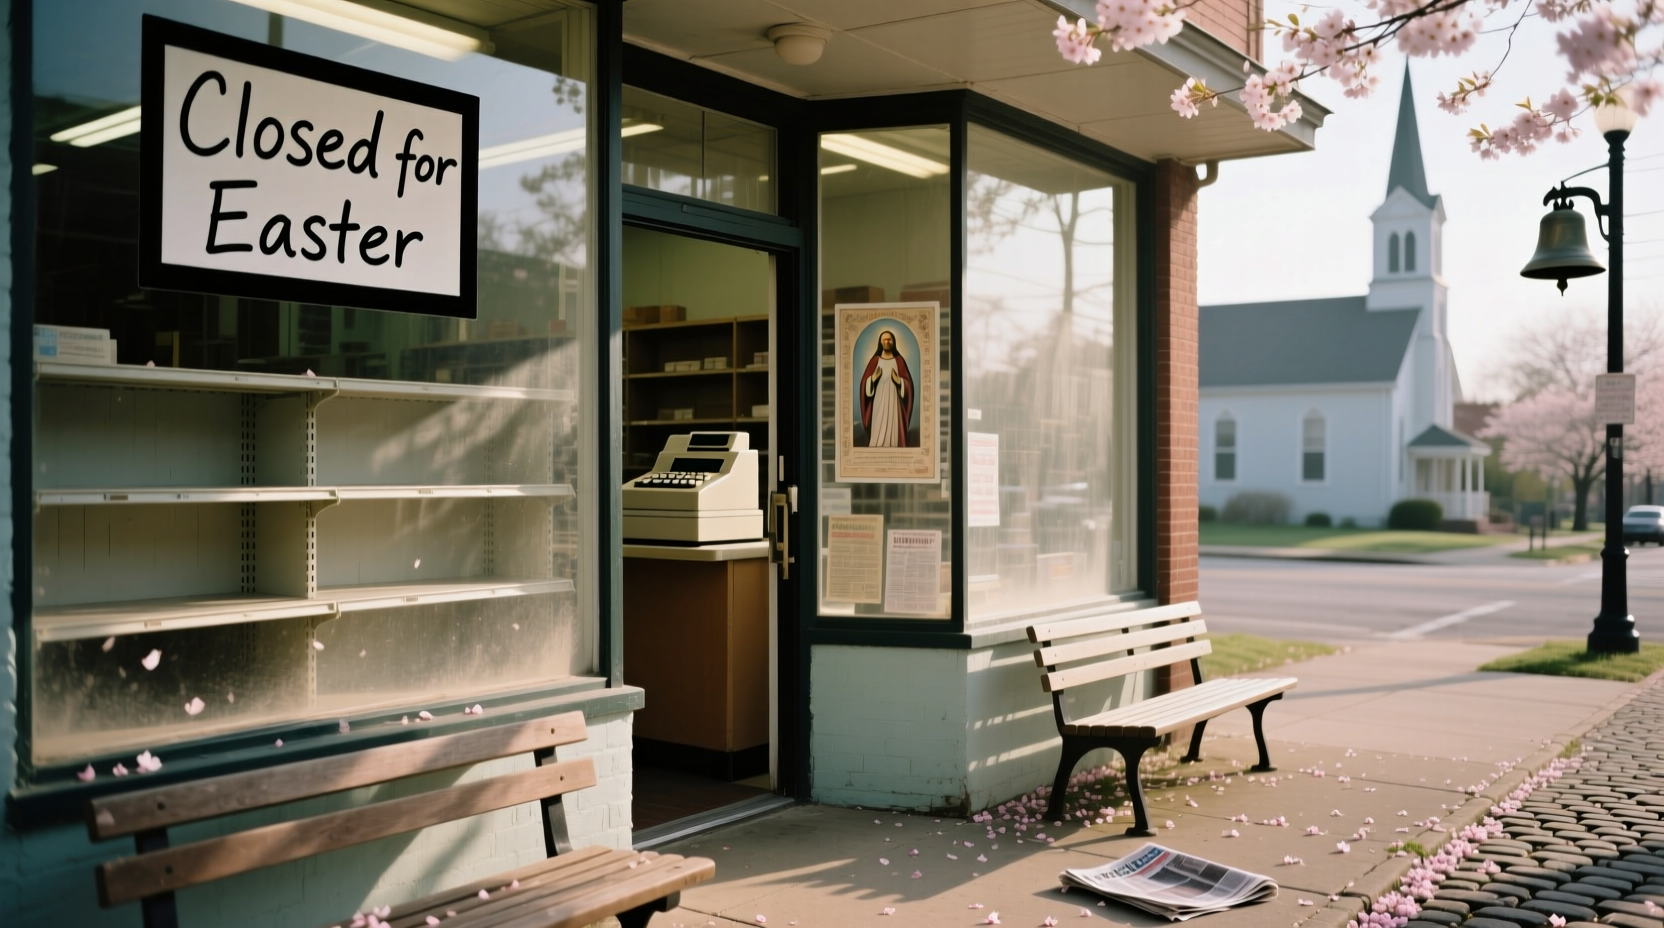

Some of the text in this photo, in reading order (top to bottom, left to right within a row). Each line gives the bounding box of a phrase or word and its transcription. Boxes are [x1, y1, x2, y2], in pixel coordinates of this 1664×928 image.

[179, 70, 458, 199] Closed for
[205, 179, 424, 269] Easter
